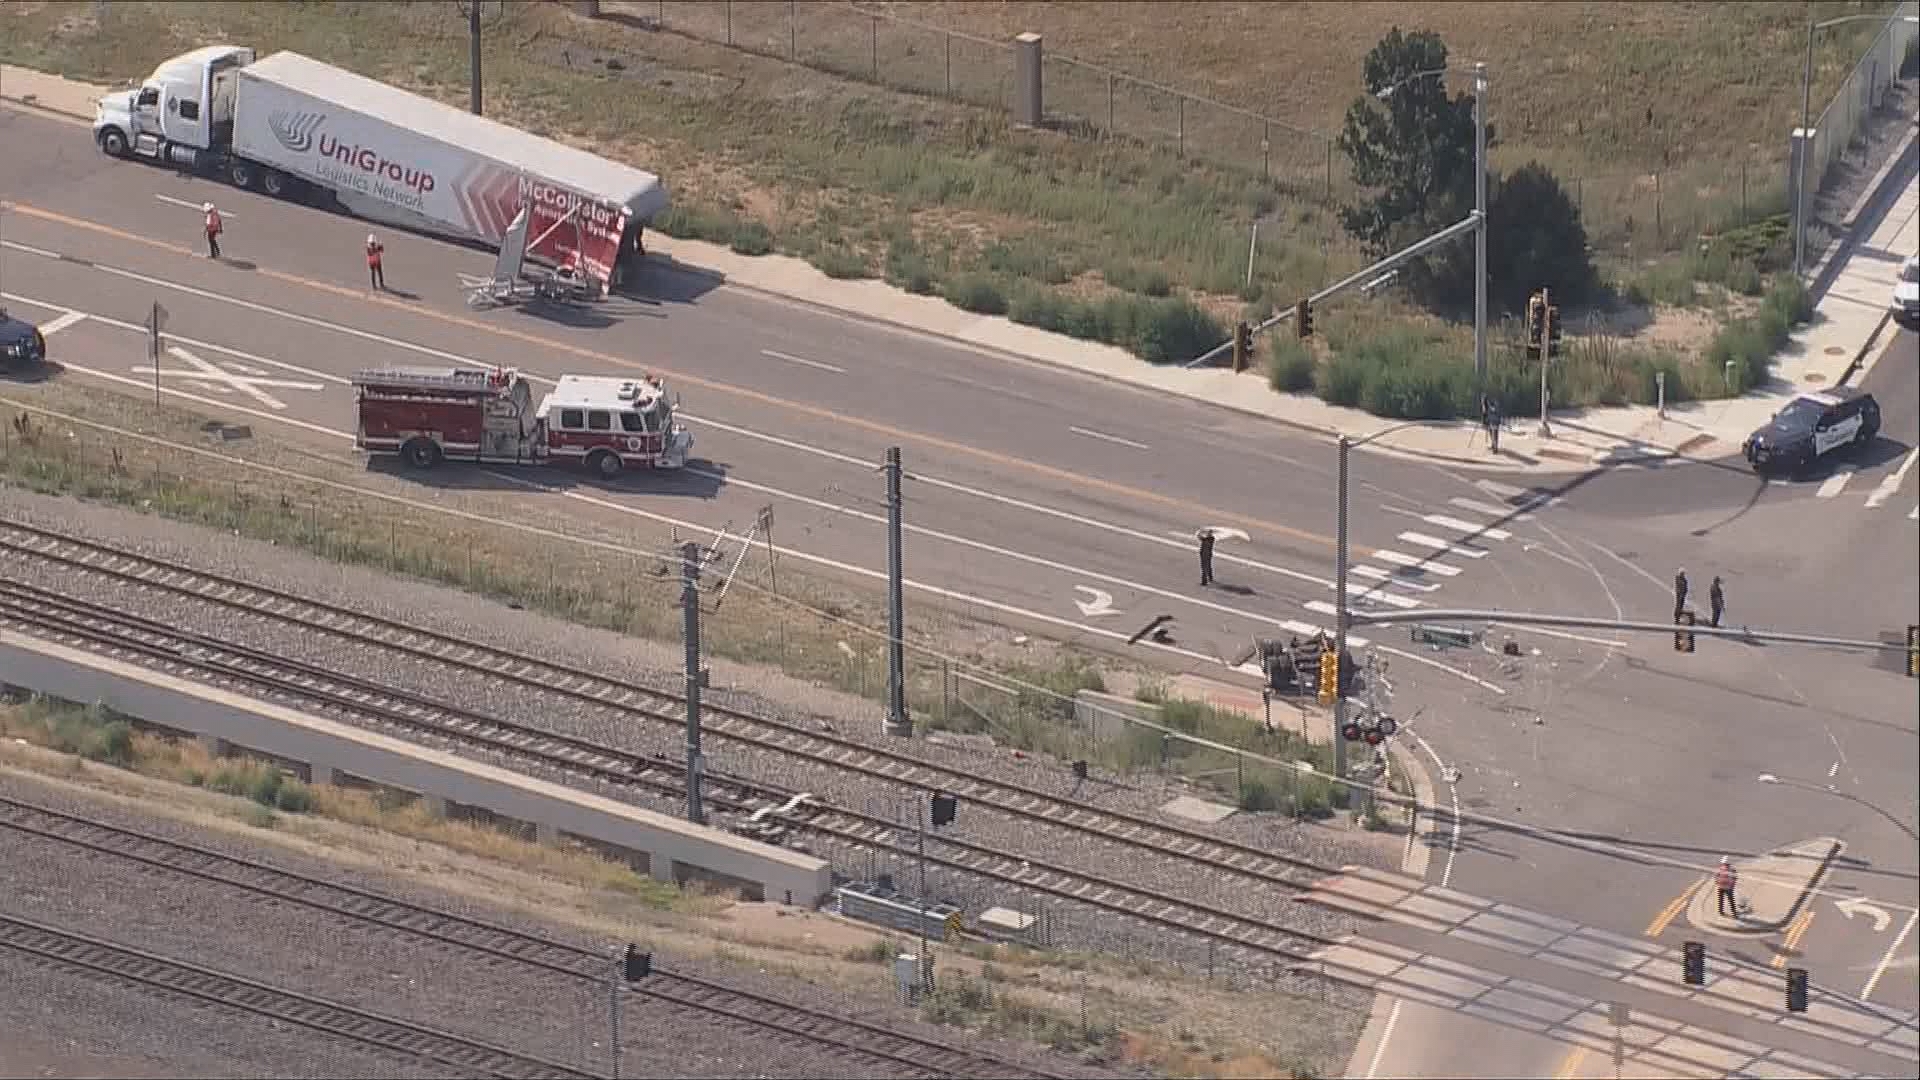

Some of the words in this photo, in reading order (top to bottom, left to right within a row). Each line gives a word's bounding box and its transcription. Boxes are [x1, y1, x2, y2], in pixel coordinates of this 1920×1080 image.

[315, 162, 369, 191] Logistics
[373, 179, 425, 211] Network
[319, 133, 435, 193] UniGroup
